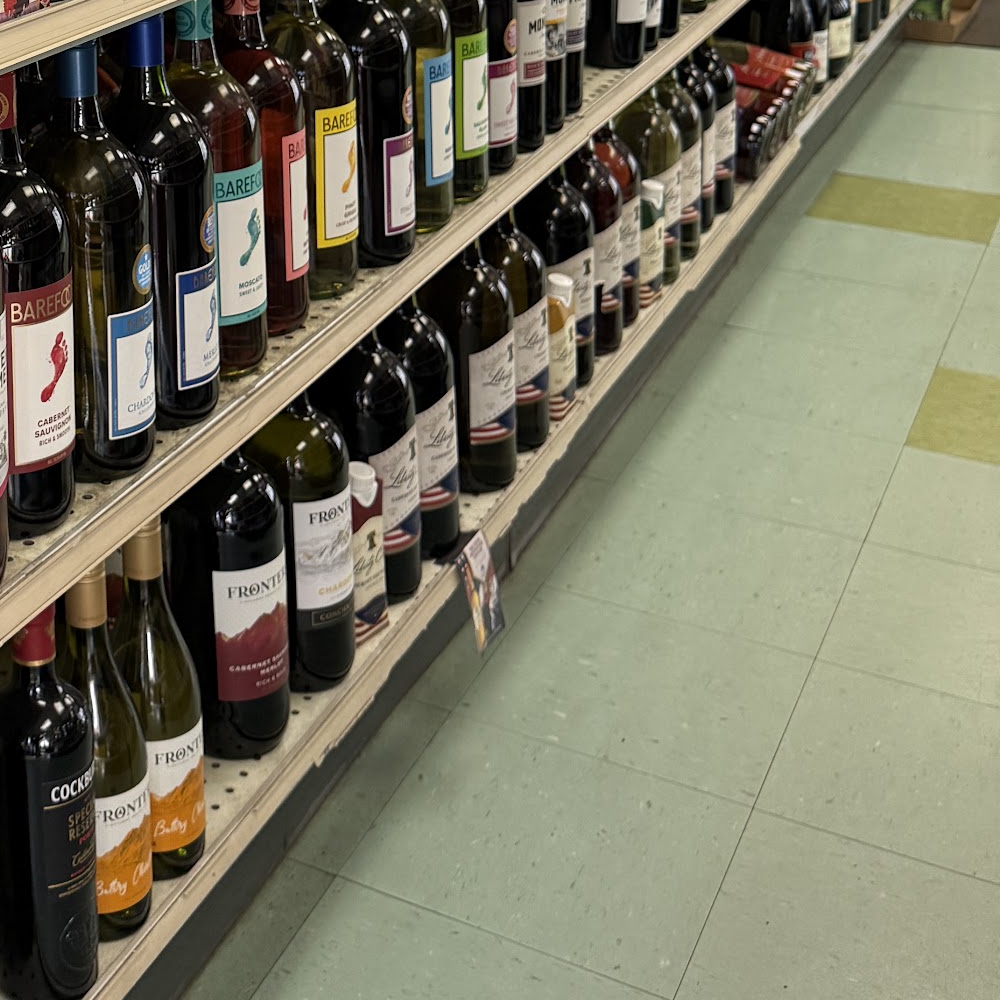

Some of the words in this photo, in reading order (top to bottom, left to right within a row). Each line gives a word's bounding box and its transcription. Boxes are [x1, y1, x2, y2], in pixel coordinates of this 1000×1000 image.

[238, 272, 263, 290] MOSCATO
[34, 413, 72, 438] SAUVIGNON
[37, 405, 70, 428] CABERNET
[39, 436, 51, 447] RICH
[228, 658, 272, 672] CABERNET
